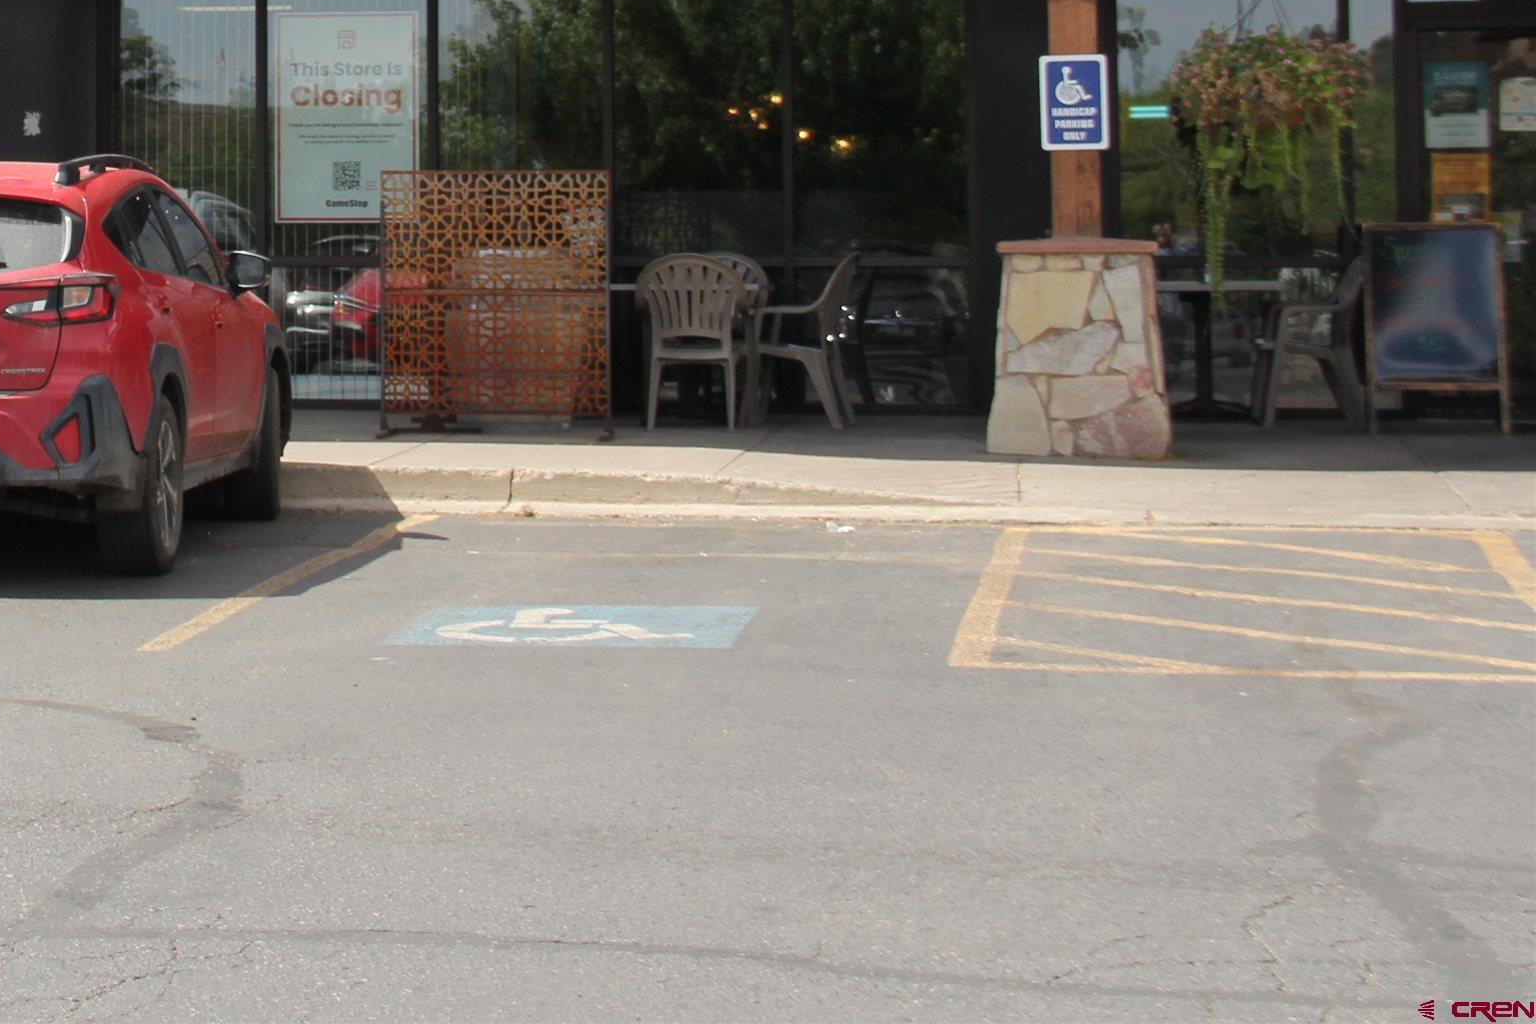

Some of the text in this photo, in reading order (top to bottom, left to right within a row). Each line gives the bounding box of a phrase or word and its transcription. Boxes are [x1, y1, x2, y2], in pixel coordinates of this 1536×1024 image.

[290, 61, 402, 77] This Store Is
[290, 83, 403, 114] Closing
[1051, 107, 1097, 117] HANDICAP
[1054, 119, 1095, 129] PARKING
[1062, 132, 1086, 141] ONLY
[325, 199, 368, 208] GameStop
